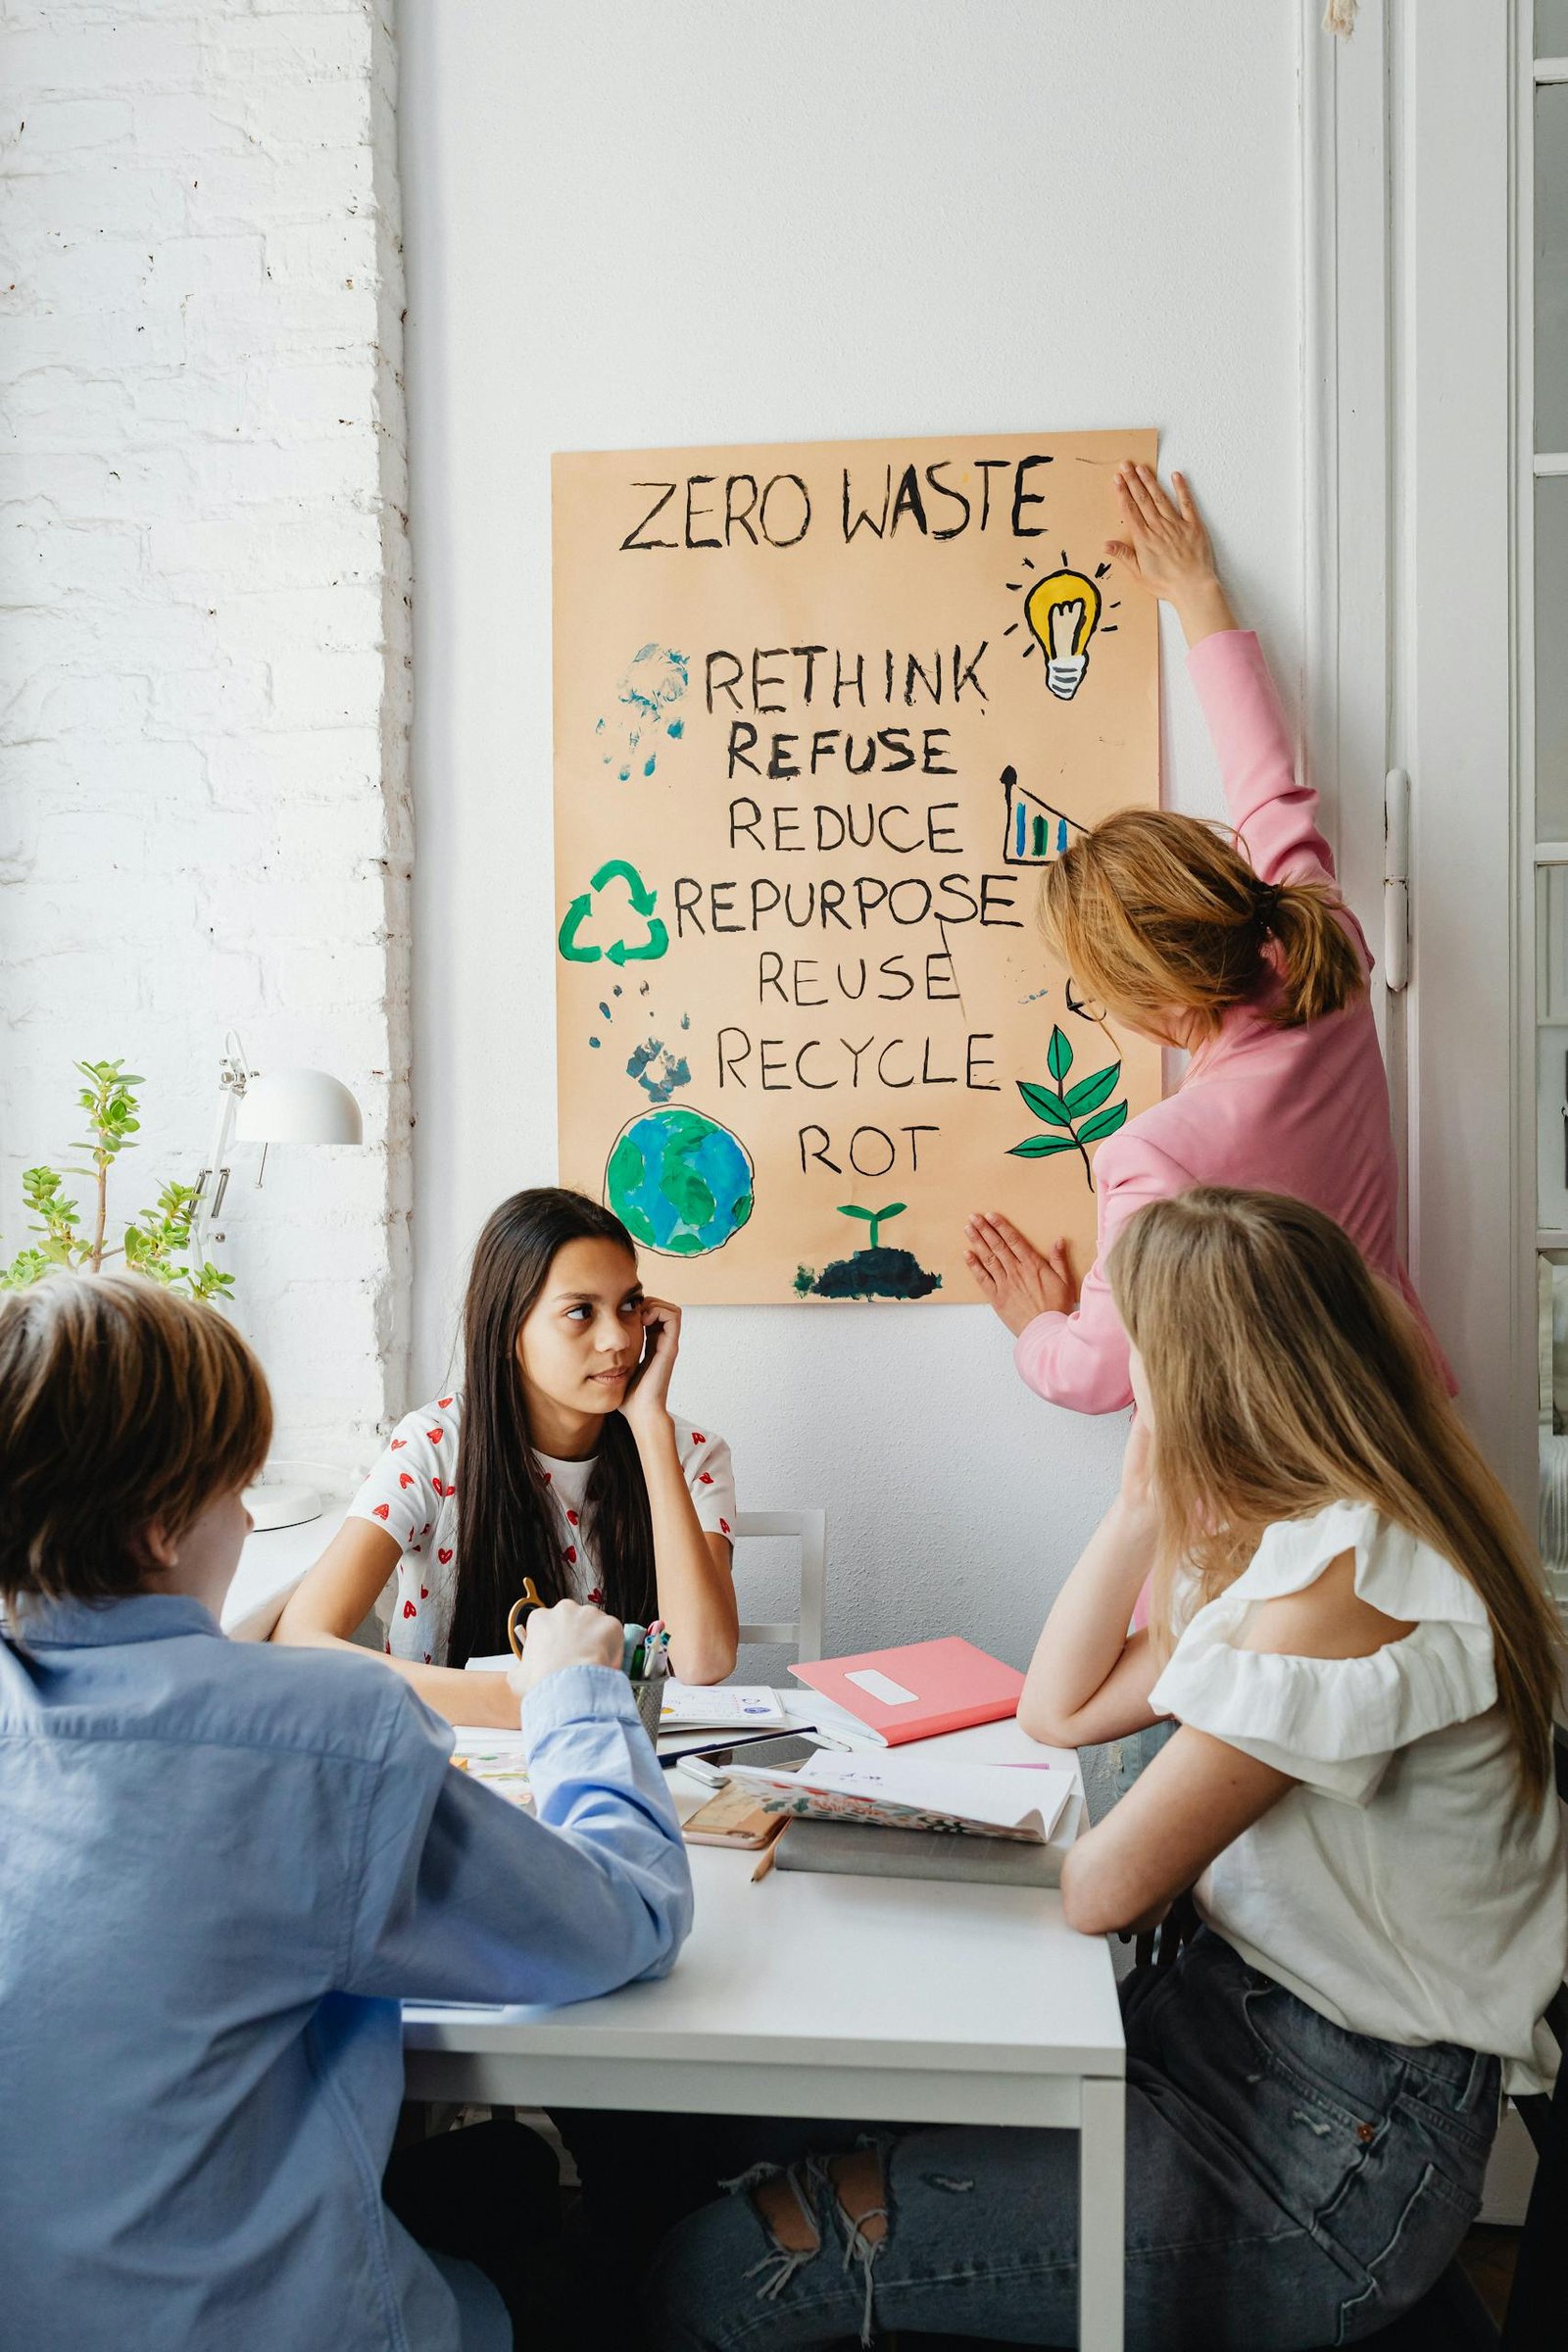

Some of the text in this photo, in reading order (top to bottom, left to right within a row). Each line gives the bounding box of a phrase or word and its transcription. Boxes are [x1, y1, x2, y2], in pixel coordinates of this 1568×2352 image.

[619, 455, 1054, 551] ZERO WASTE
[706, 641, 989, 713] RETHINK
[728, 721, 957, 779] REFUSE
[730, 798, 963, 853] REDUCE
[674, 873, 1024, 938] REPURPOSE
[760, 952, 960, 1006] REUSE
[717, 1027, 1002, 1091] RECYCLE
[799, 1125, 940, 1176] ROT
